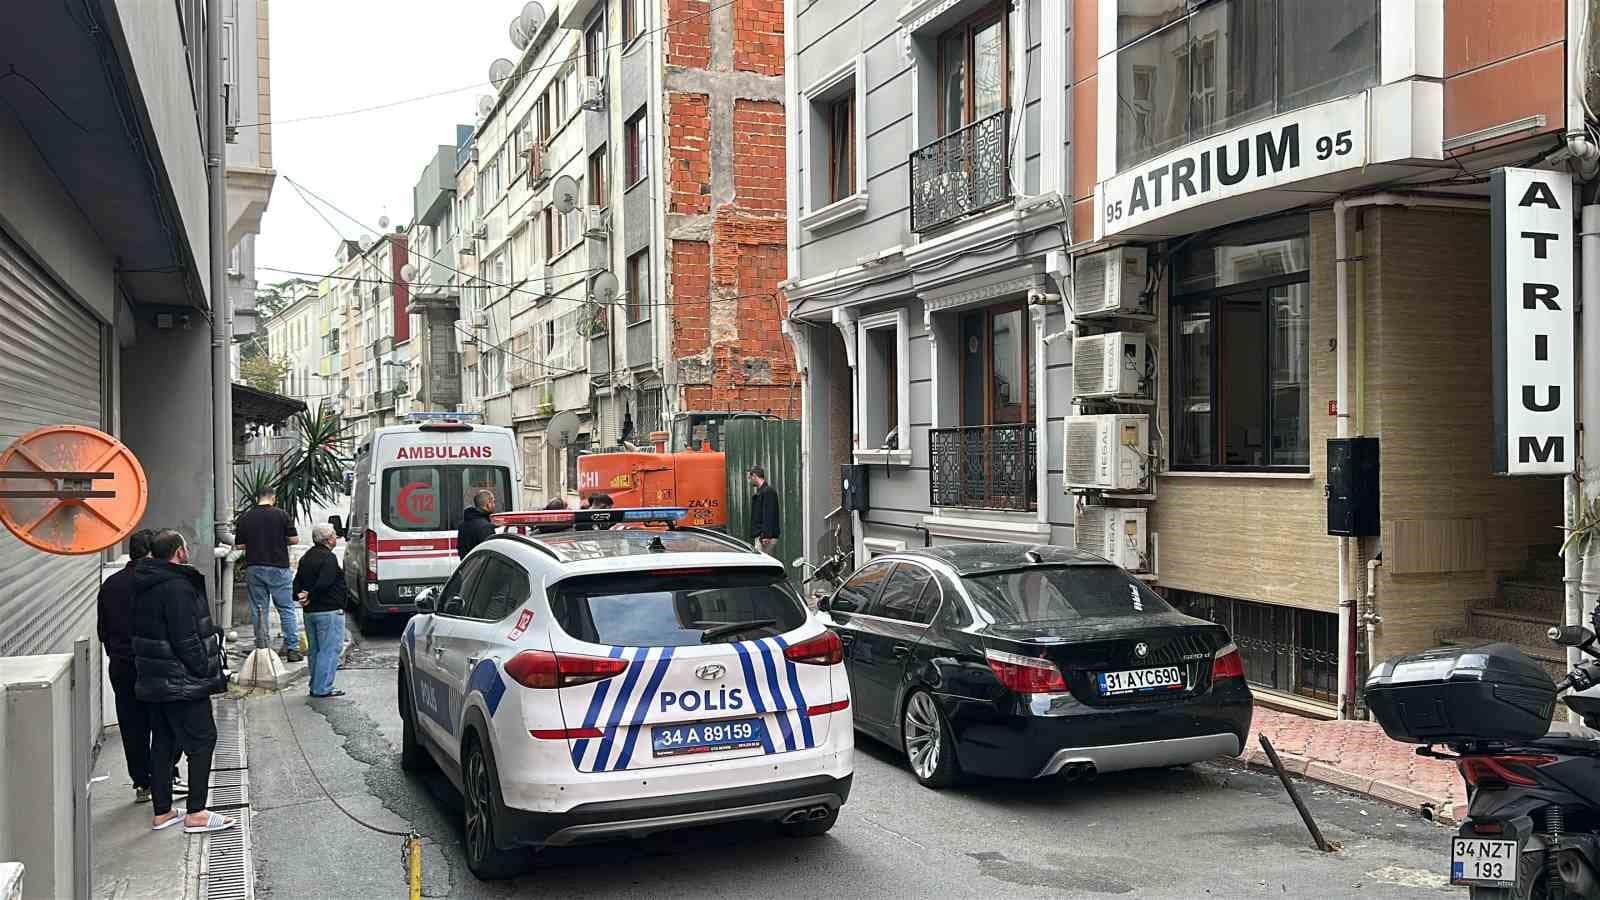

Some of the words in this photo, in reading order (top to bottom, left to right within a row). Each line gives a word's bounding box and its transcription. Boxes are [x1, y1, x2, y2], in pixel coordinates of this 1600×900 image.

[1106, 199, 1123, 224] 95
[1127, 122, 1299, 216] ATRIUM
[1315, 129, 1353, 161] 95
[1518, 181, 1565, 464] ATRIUM
[396, 446, 492, 460] AMBULANS
[578, 471, 599, 488] CHI
[1106, 673, 1122, 689] 31
[1127, 668, 1179, 687] AYC690
[661, 684, 743, 712] POLİS
[662, 730, 683, 746] 34
[687, 728, 700, 743] A
[704, 723, 752, 742] 89159
[1456, 841, 1475, 857] 34
[1480, 842, 1515, 859] NZT
[1474, 862, 1503, 878] 193
